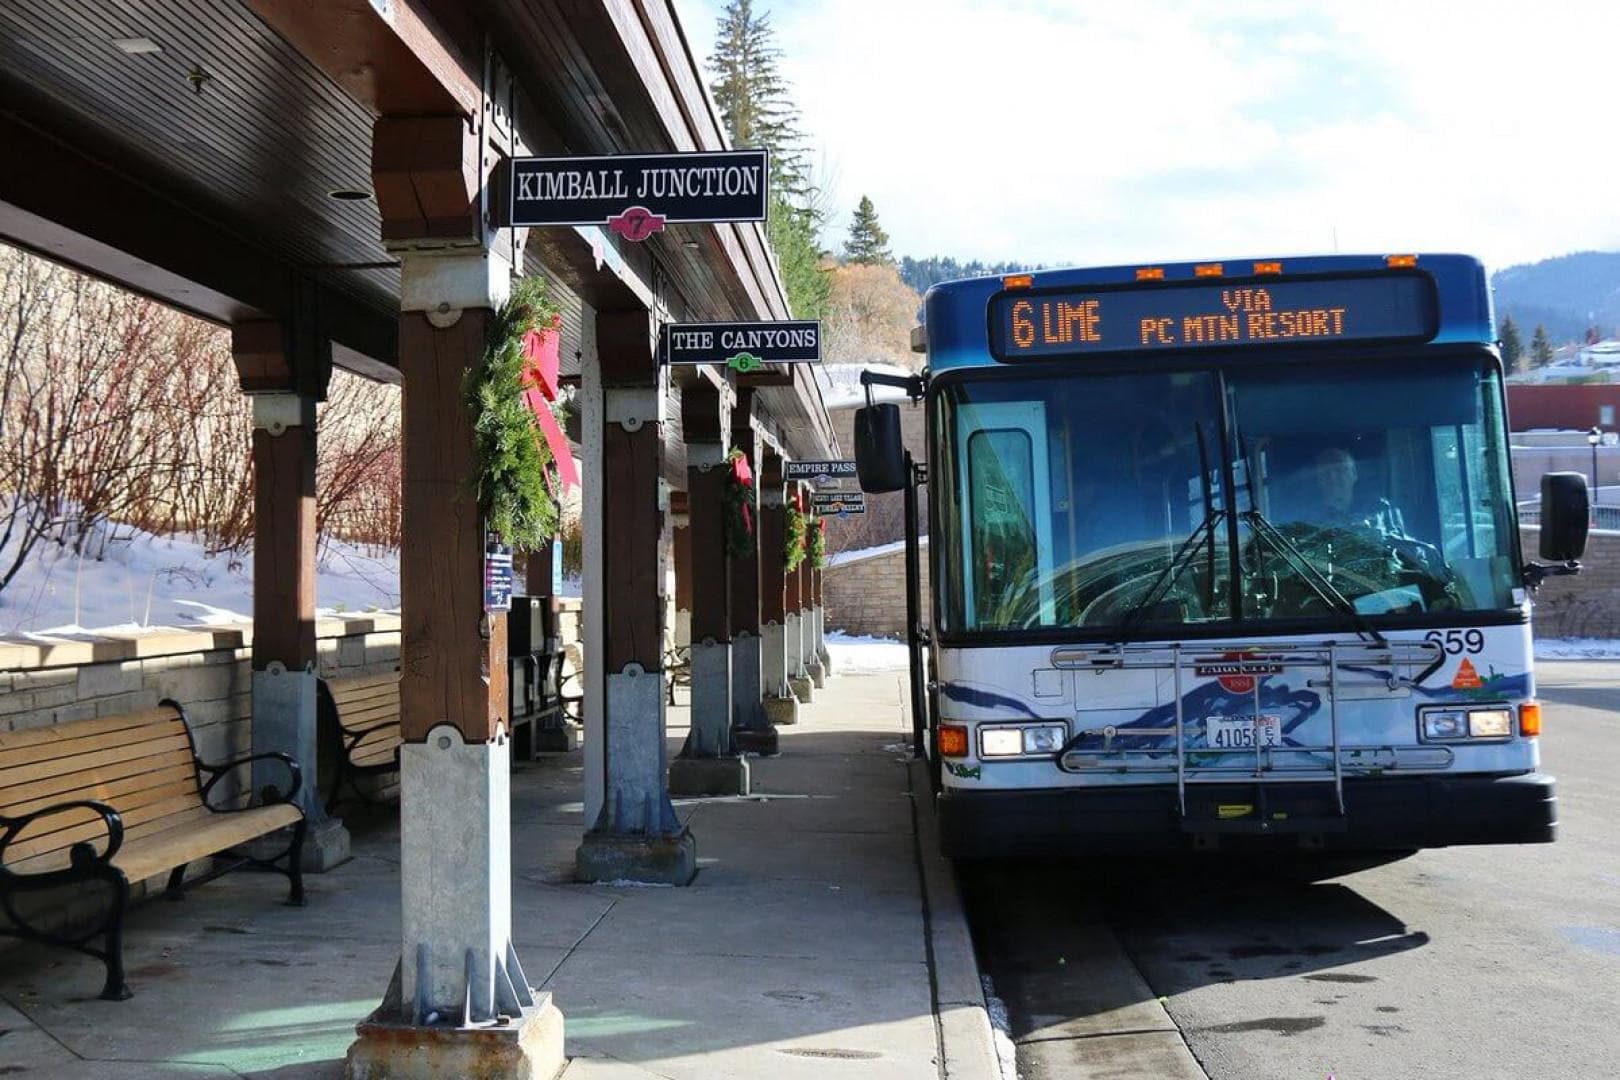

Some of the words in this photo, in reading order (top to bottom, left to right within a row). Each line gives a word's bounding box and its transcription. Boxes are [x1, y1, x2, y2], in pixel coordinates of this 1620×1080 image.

[517, 170, 628, 201] KIMBALL
[637, 166, 759, 198] JUNCTION
[629, 216, 645, 235] 7
[1223, 289, 1271, 312] VIA
[1011, 300, 1034, 348] 6
[1043, 300, 1101, 344] LIME
[1141, 316, 1174, 345] PC
[1183, 313, 1240, 342] MTN
[1248, 309, 1345, 337] RESORT
[672, 331, 714, 350] THE
[720, 329, 817, 349] CANYONS
[739, 357, 749, 370] 6
[789, 463, 830, 474] EMPIRE
[831, 463, 856, 472] PASS
[1425, 628, 1485, 655] 659
